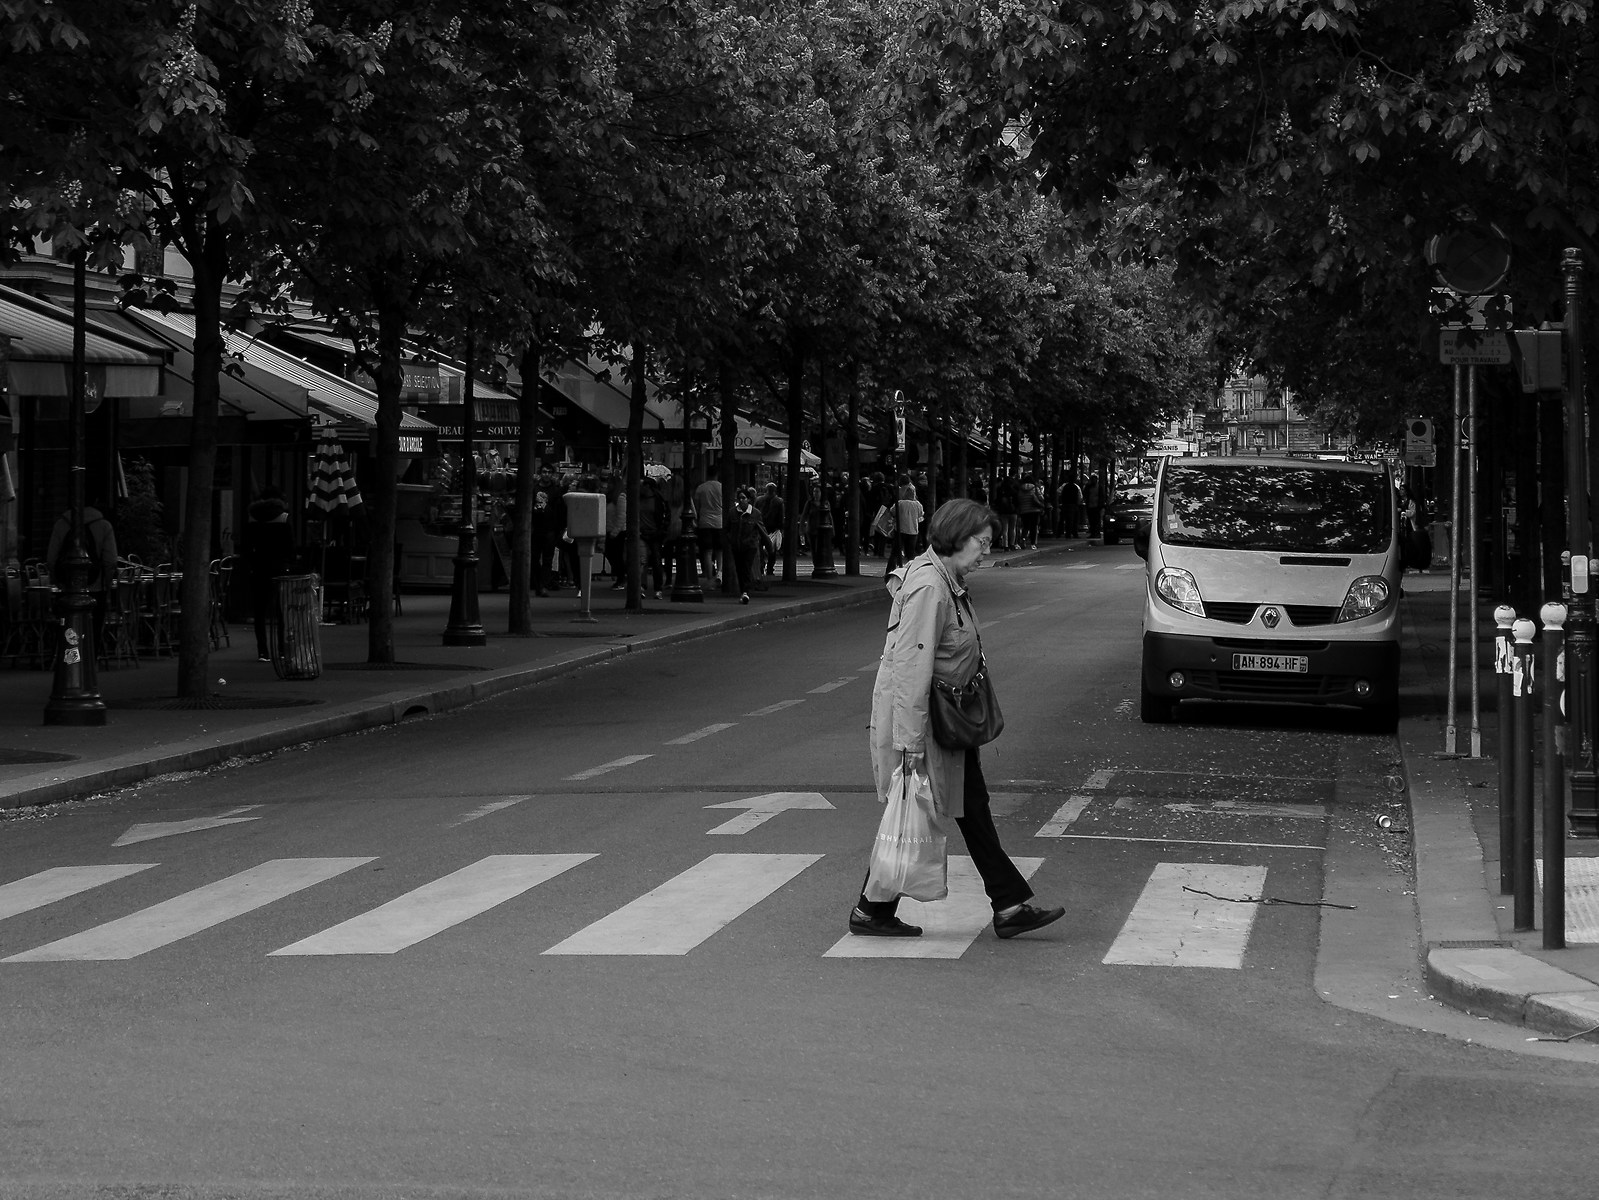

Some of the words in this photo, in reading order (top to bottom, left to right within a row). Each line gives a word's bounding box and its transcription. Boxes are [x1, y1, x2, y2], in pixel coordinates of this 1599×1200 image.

[438, 425, 465, 436] DEAU
[487, 425, 545, 436] SOUVES
[1241, 655, 1299, 670] AN-894-HF
